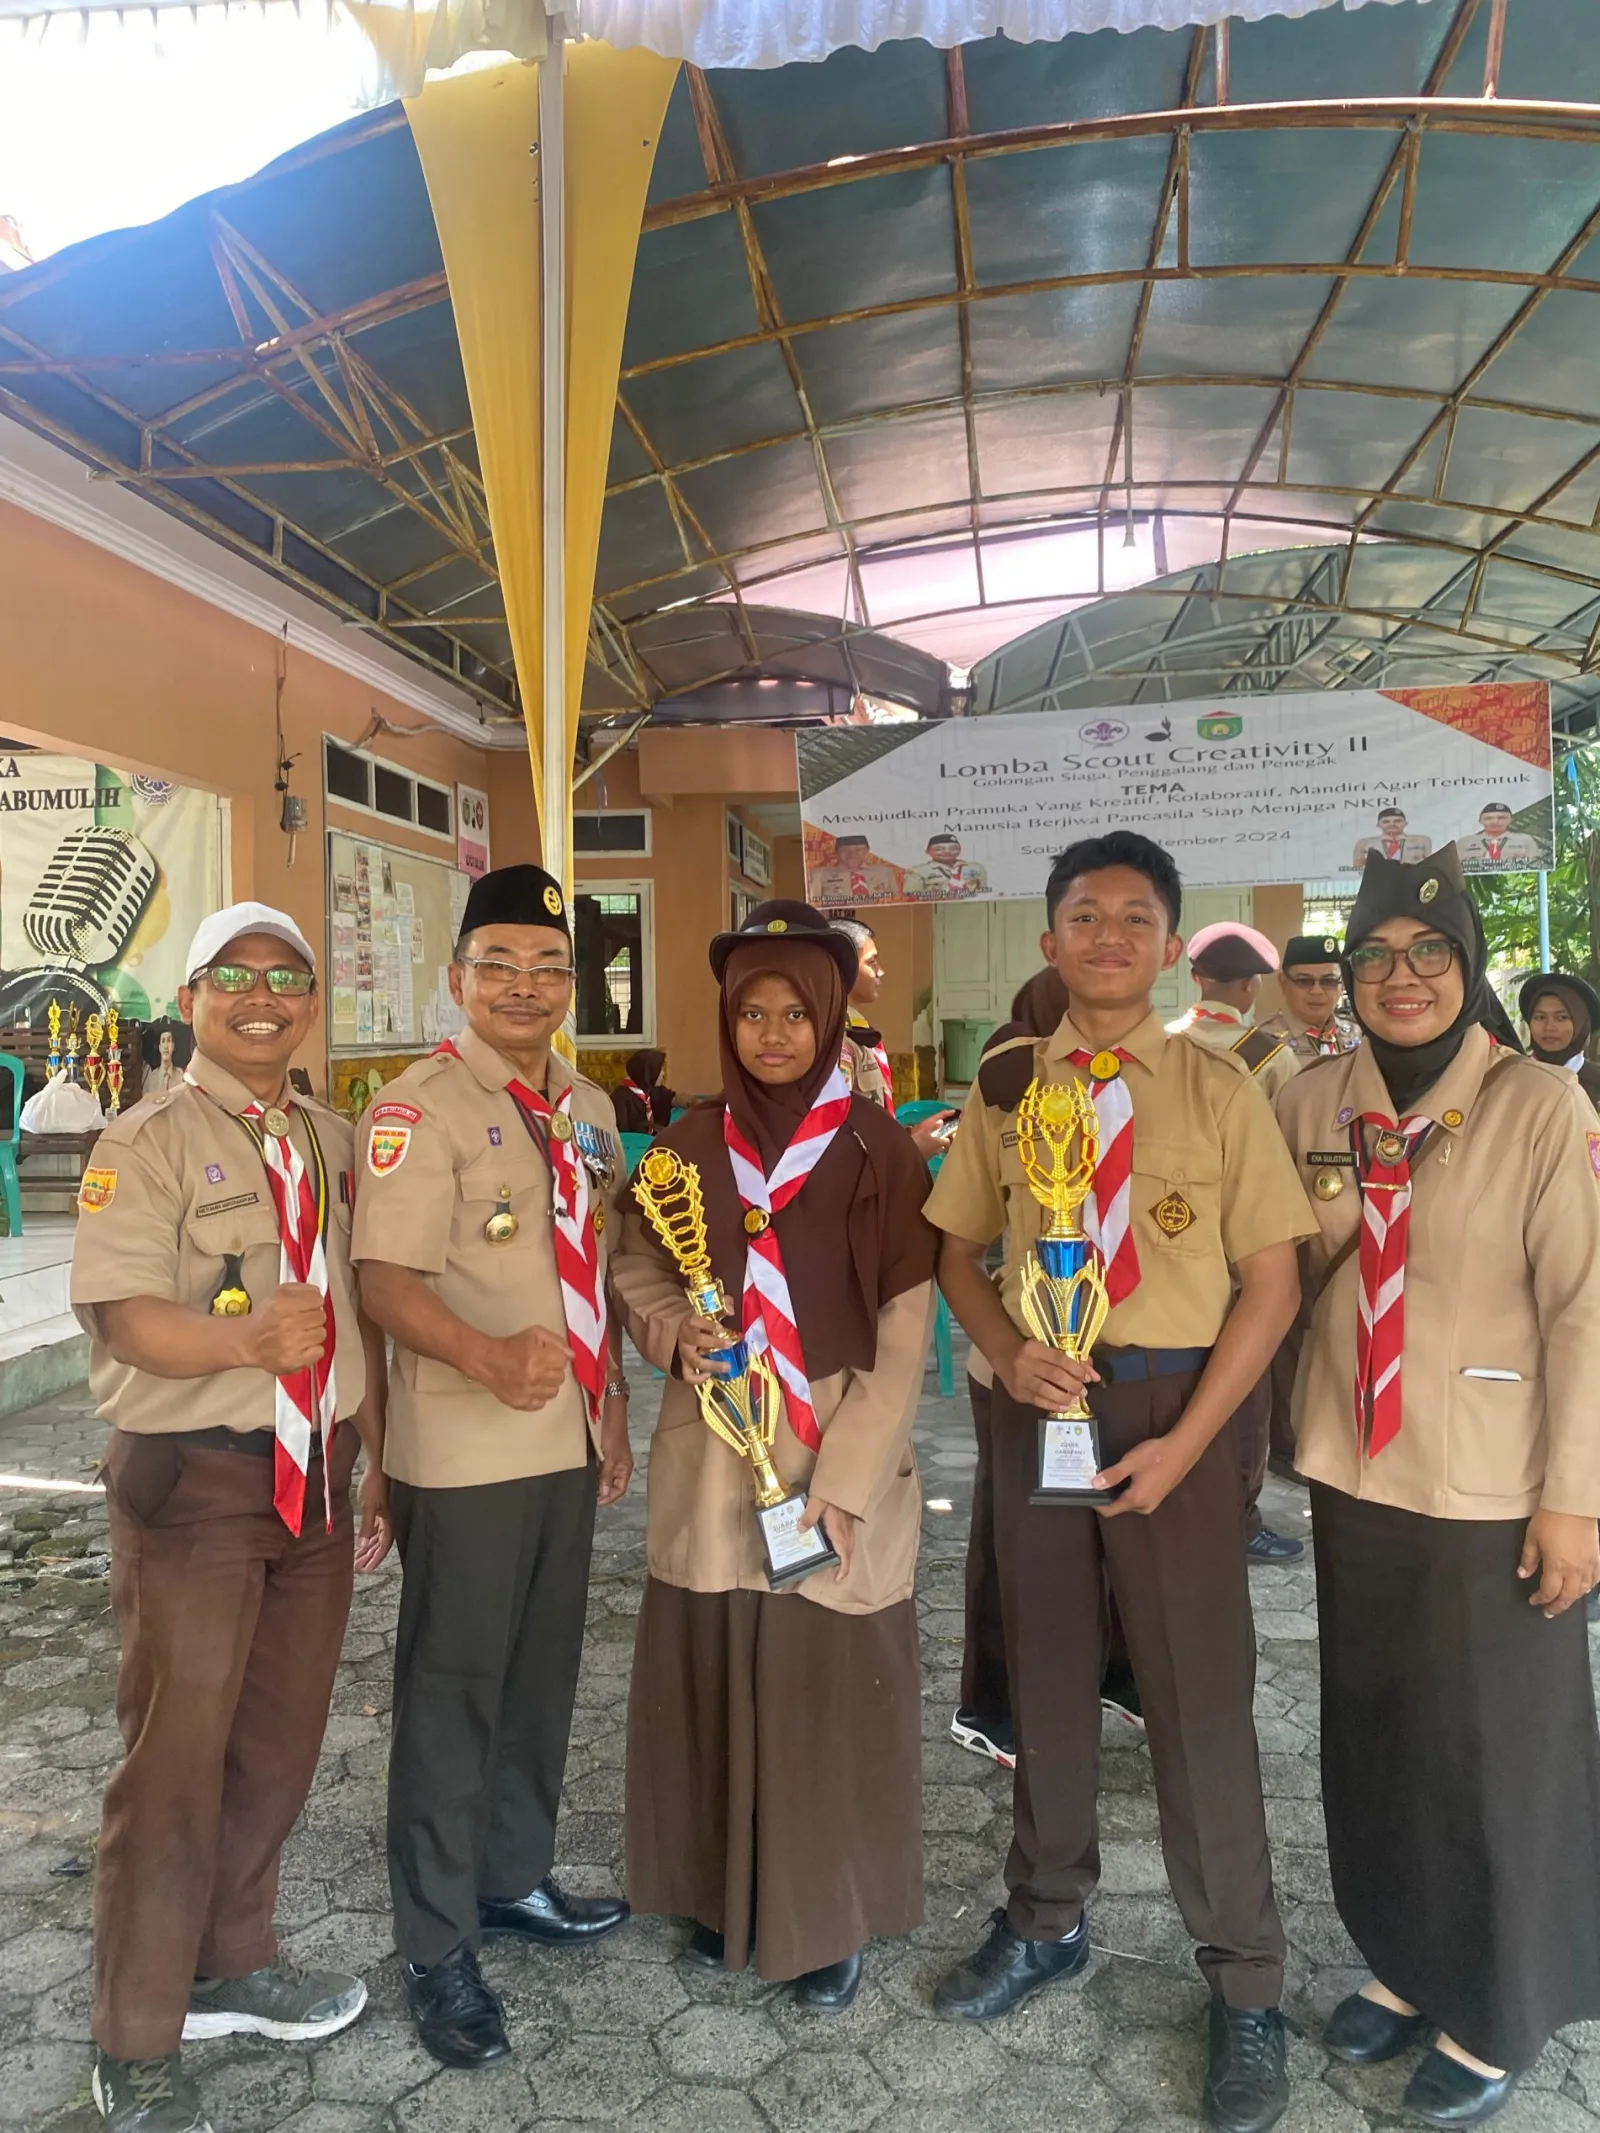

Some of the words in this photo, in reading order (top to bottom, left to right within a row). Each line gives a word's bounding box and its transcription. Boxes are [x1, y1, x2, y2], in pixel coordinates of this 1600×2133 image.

[940, 758, 1048, 778] Lomba
[1063, 753, 1155, 770] Scout
[1169, 741, 1334, 763] Creativity
[1349, 736, 1367, 752] II
[973, 776, 1054, 787] Golongan
[1061, 772, 1111, 782] Siaga,
[1118, 765, 1218, 779] Penggalang
[1224, 762, 1255, 772] dan
[1262, 757, 1338, 768] Penegak
[822, 809, 939, 824] Mewujudkan
[947, 803, 1028, 817] Pramuka
[1036, 800, 1082, 812] Yang
[1090, 794, 1160, 808] Kreatif,
[1168, 787, 1281, 803] Kolaboratif,
[1290, 781, 1366, 795] Mandiri
[1373, 780, 1421, 792] Agar
[1427, 773, 1532, 788] Terbentuk
[1120, 782, 1185, 795] TEMA
[943, 820, 1021, 833] Manusia
[1028, 815, 1100, 828] Berjiwa
[1107, 809, 1194, 823] Pancasila
[1202, 806, 1244, 818] Siap
[1251, 801, 1336, 814] Menjaga
[1344, 797, 1397, 809] NKRI
[1020, 844, 1067, 855] Sabt
[1158, 835, 1228, 847] tember
[1235, 830, 1291, 843] 2024
